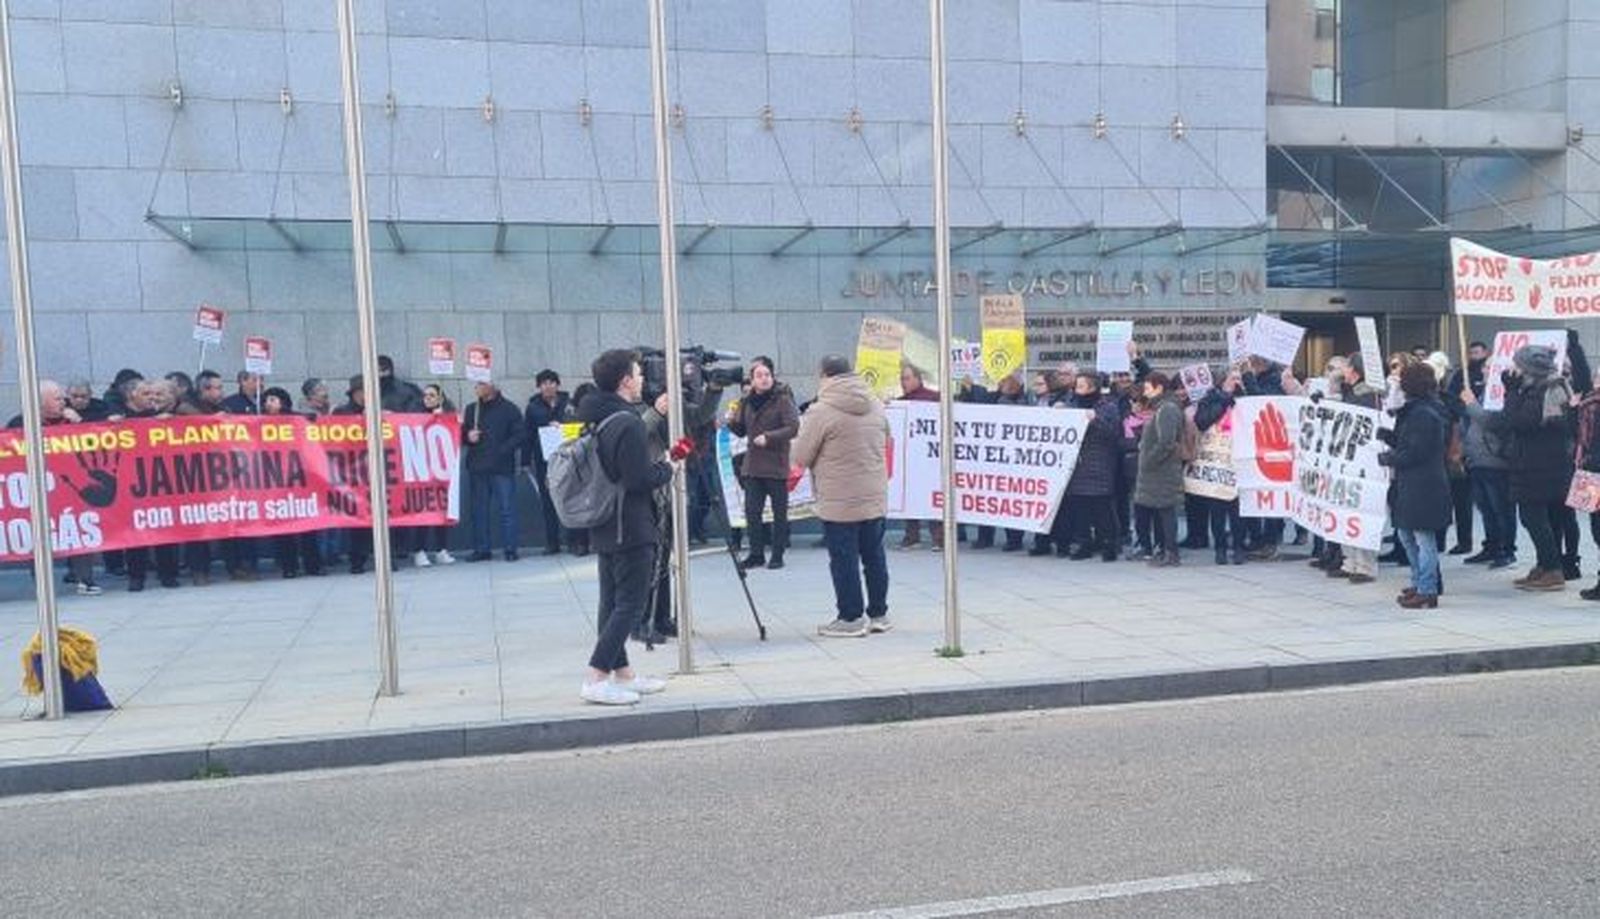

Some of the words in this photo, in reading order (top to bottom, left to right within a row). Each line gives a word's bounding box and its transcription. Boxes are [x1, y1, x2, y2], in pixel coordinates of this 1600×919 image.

[1457, 254, 1509, 279] STOP
[1007, 268, 1149, 298] CASTILLA
[1153, 268, 1173, 294] Y
[149, 423, 250, 446] PLANTA
[261, 423, 294, 442] DE
[971, 421, 997, 439] TU
[130, 449, 307, 499] JAMBRINA
[400, 423, 452, 483] NO
[984, 447, 1010, 466] EL
[133, 506, 174, 530] con
[180, 495, 260, 525] nuestra
[264, 492, 320, 520] salud
[327, 490, 358, 517] NO
